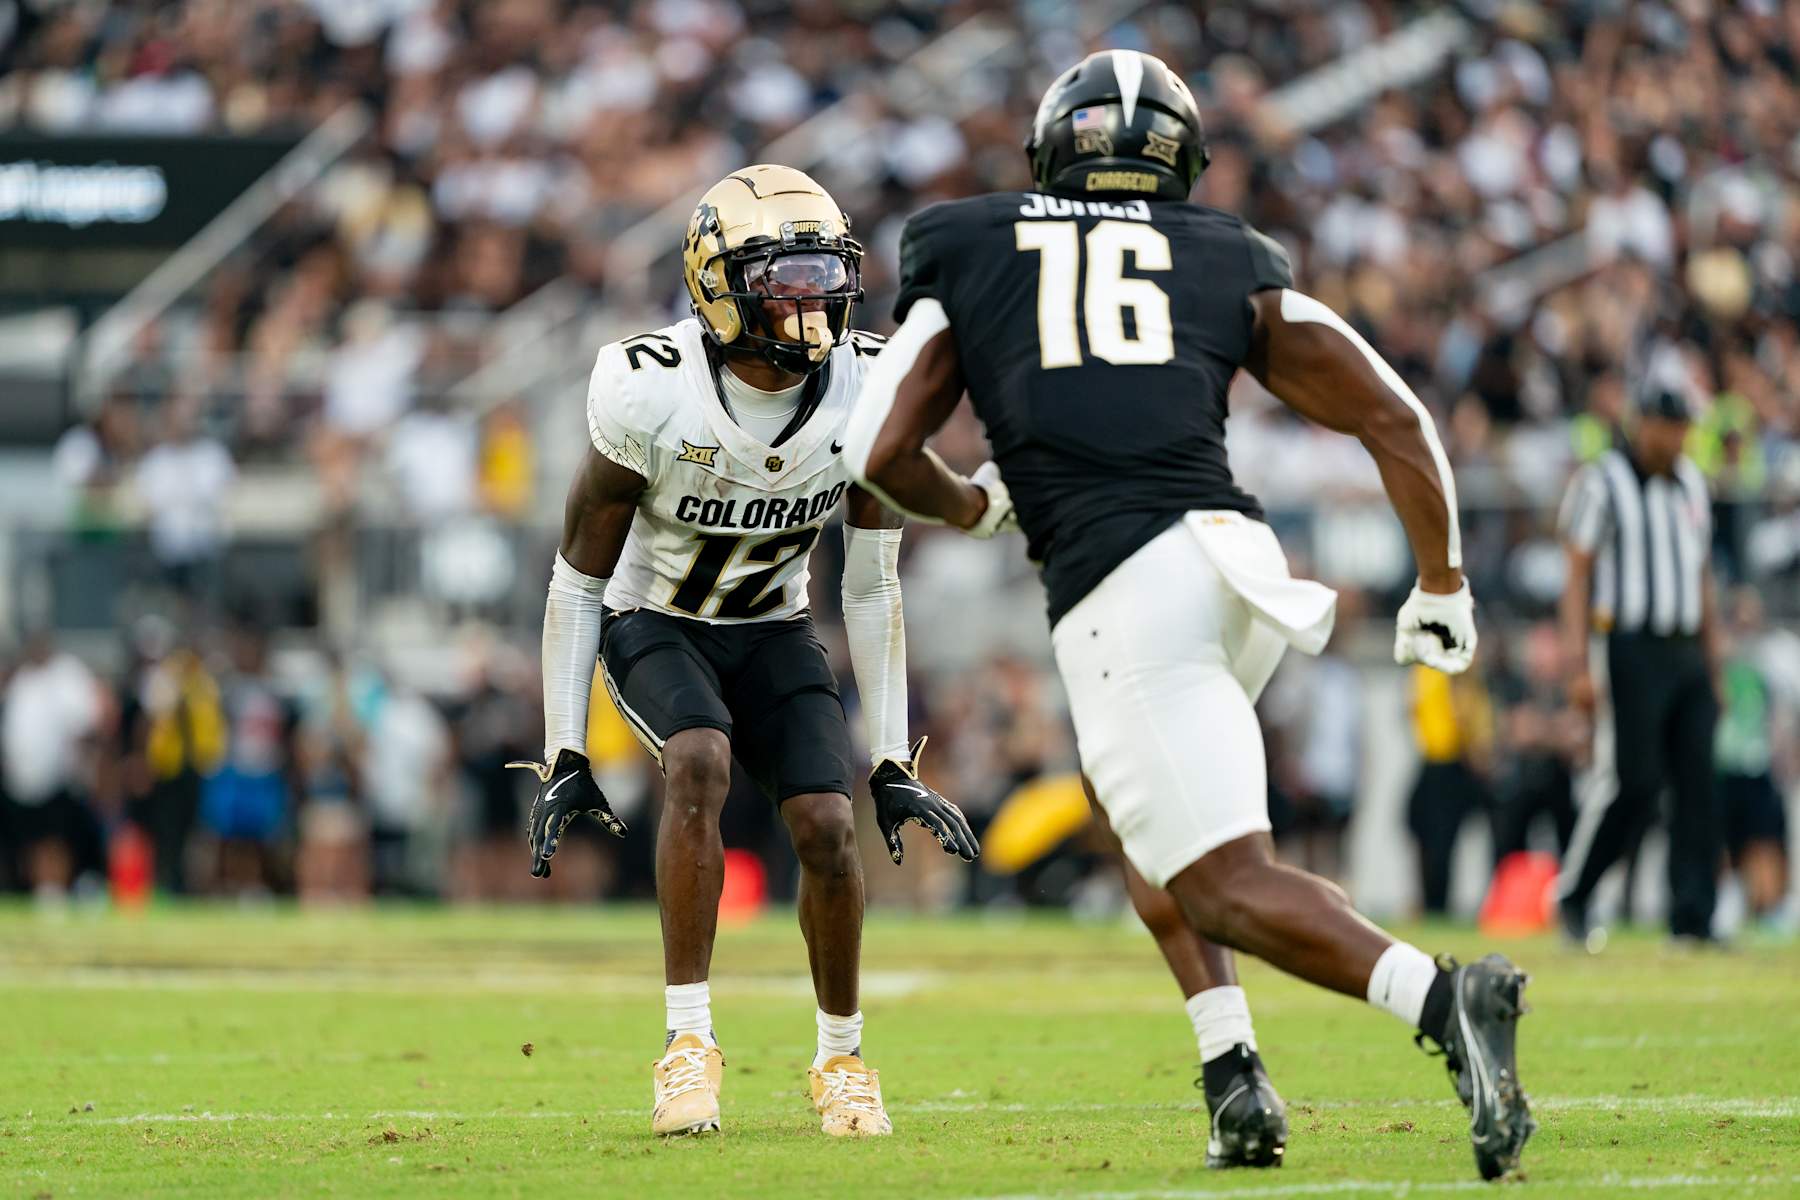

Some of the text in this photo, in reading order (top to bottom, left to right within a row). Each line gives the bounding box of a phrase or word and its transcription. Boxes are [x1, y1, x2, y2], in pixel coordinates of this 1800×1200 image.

[1014, 219, 1176, 369] 16
[620, 333, 682, 371] 12
[675, 480, 847, 529] COLORADO
[664, 521, 824, 619] 12
